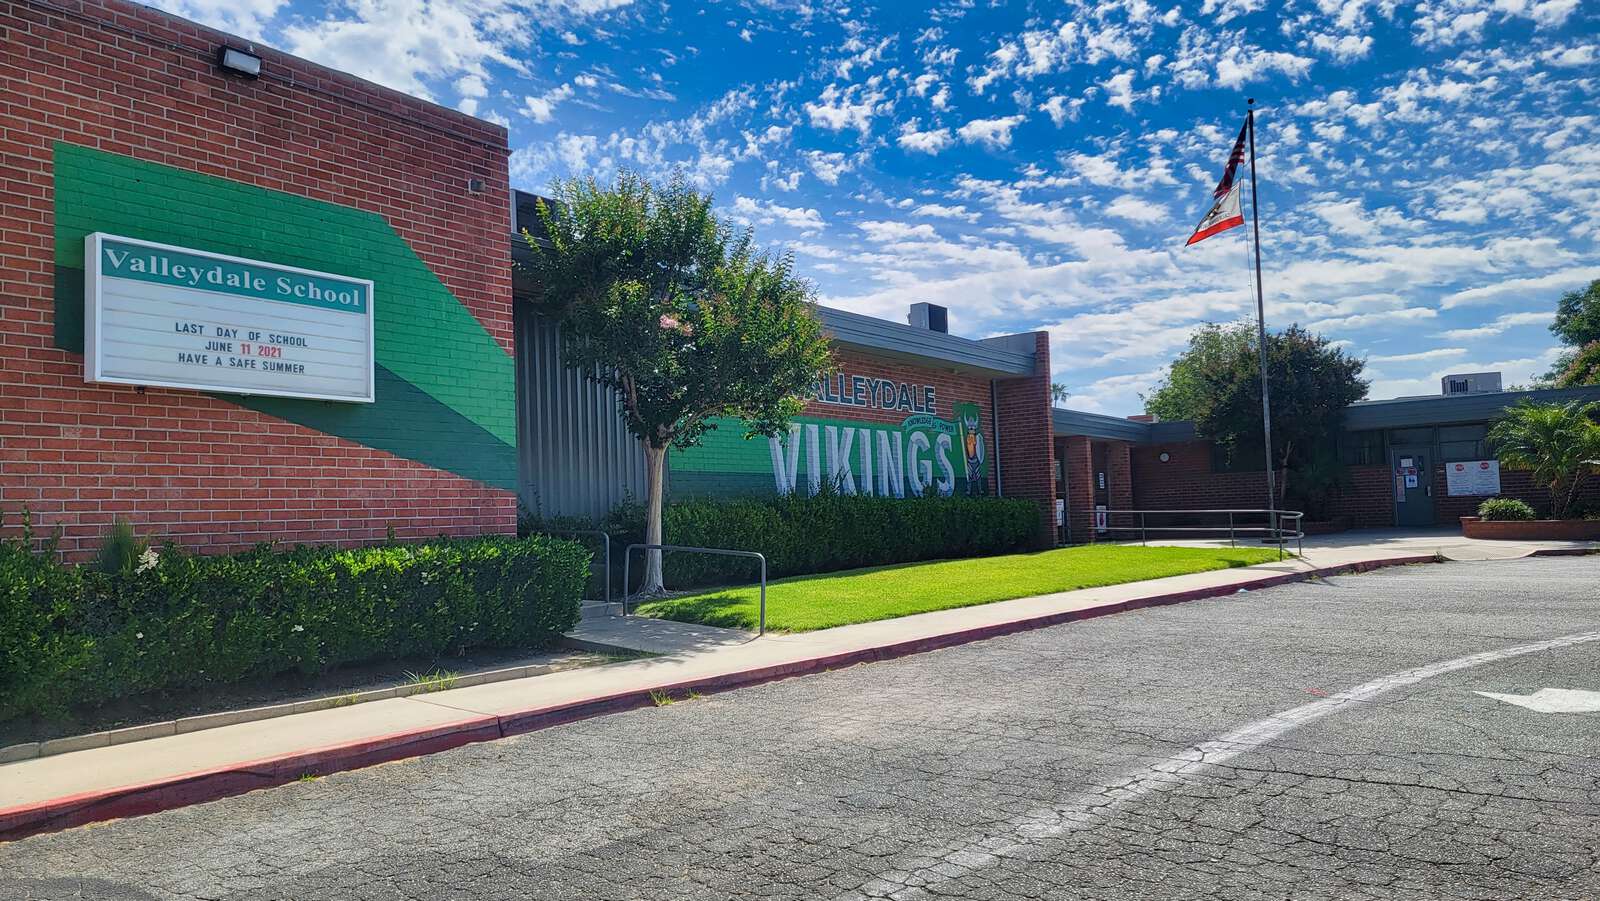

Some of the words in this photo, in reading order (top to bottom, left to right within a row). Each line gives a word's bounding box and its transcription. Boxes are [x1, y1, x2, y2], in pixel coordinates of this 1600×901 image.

[103, 248, 267, 291] Valleydale
[276, 276, 361, 307] School
[175, 322, 204, 335] LAST
[216, 327, 238, 339] DAY
[248, 331, 261, 341] OF
[269, 334, 308, 347] SCHOOL
[205, 341, 233, 353] JUNE
[240, 343, 251, 355] 11
[258, 345, 281, 358] 2021
[178, 352, 208, 364] HAVE
[215, 356, 223, 366] A
[229, 357, 256, 369] SAFE
[262, 360, 305, 374] SUMMER
[796, 371, 936, 415] ALLEYDALE
[769, 422, 956, 499] VIKINGS
